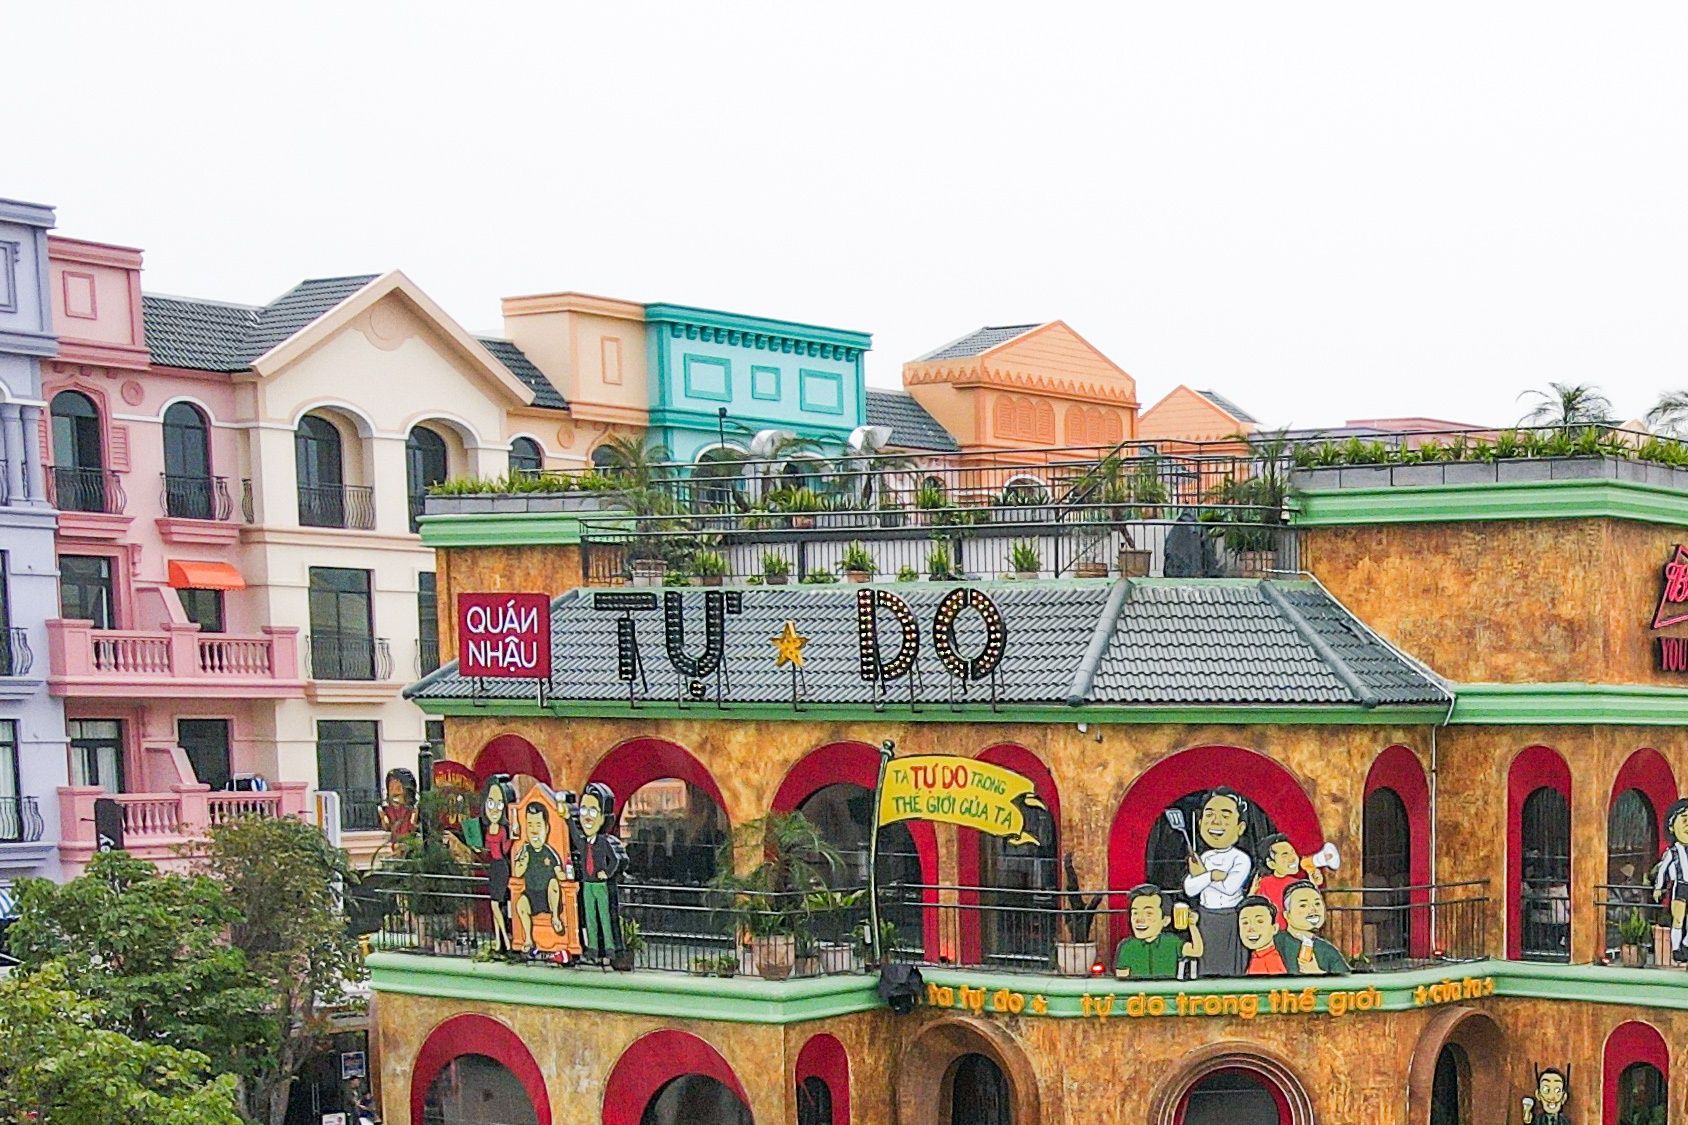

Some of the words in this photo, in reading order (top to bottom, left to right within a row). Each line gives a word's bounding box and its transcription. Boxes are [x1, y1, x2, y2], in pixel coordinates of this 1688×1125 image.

[466, 599, 538, 634] QUÁN
[468, 635, 537, 672] NHẬU
[594, 590, 742, 697] TỰ
[857, 588, 1008, 681] DO
[893, 769, 909, 784] TA
[910, 763, 938, 794] TỰ
[942, 764, 968, 789] DO
[970, 771, 1006, 795] TRONG
[892, 788, 922, 814] THẾ
[994, 805, 1012, 829] TA
[926, 982, 955, 1008] ta
[993, 988, 1025, 1014] do
[1126, 991, 1166, 1017] do
[1175, 991, 1259, 1019] trong
[1268, 985, 1318, 1014] thế
